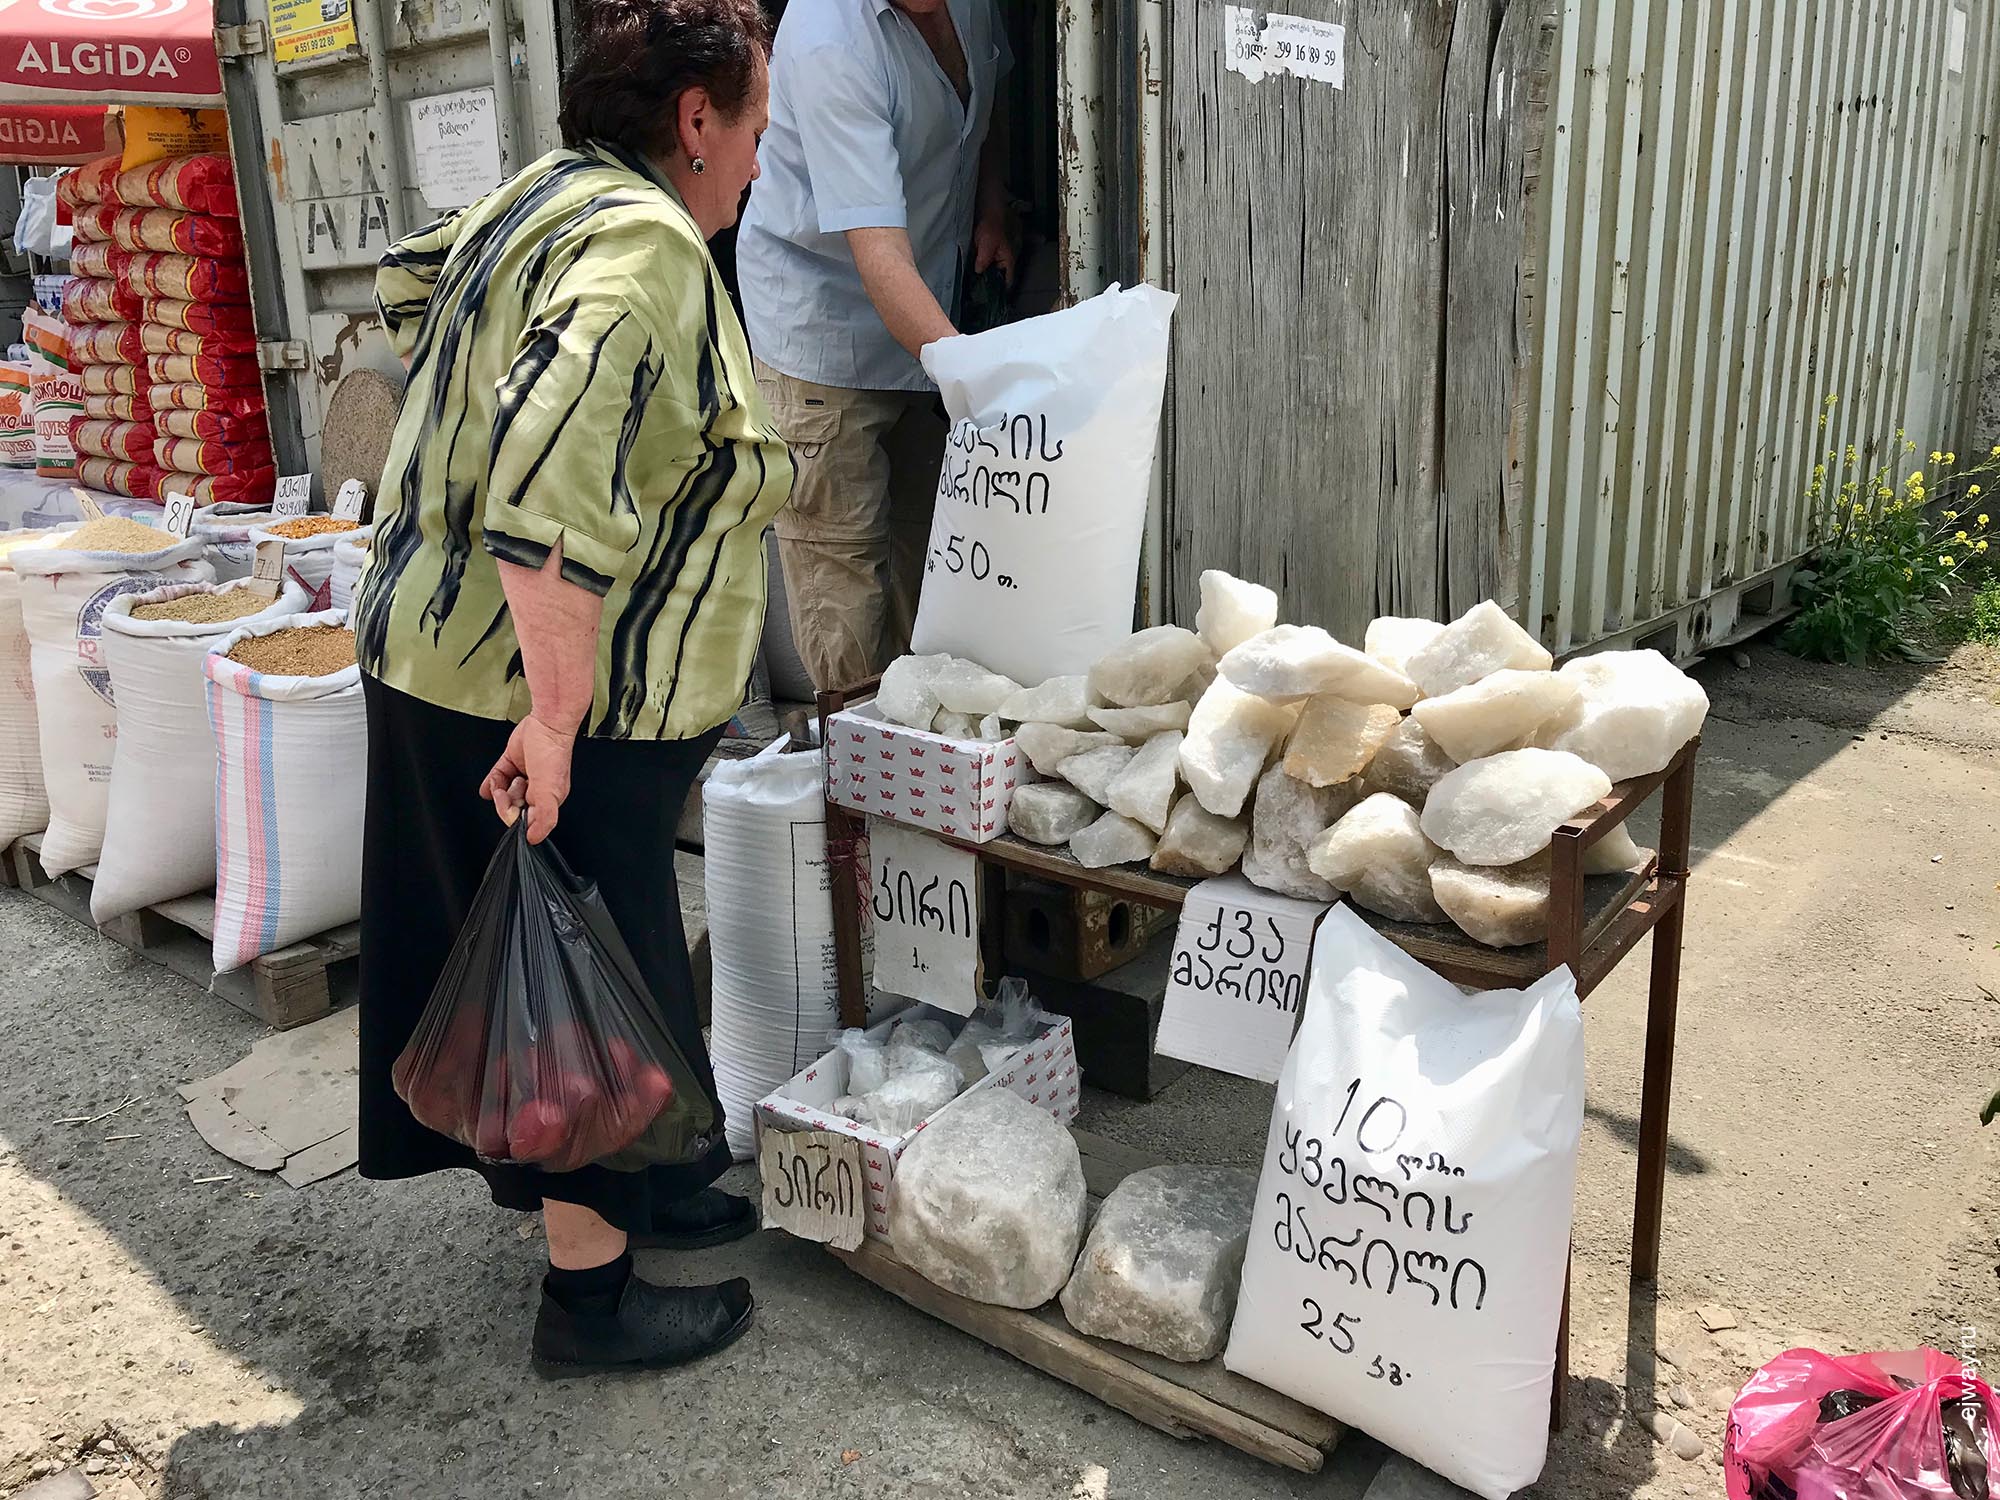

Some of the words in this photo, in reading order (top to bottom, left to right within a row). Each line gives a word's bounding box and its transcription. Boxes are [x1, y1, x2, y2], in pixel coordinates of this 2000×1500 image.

[1295, 44, 1306, 61] 16
[1324, 49, 1336, 66] 59
[168, 501, 191, 534] 80
[873, 866, 970, 938] კირი
[1197, 907, 1284, 963] ქვა
[1174, 951, 1301, 1013] მარილი
[1333, 1078, 1407, 1153] 10
[775, 1151, 854, 1218] კირი
[1279, 1120, 1473, 1234] ყველის
[1274, 1193, 1487, 1310] მარილი
[1301, 1298, 1361, 1354] 25
